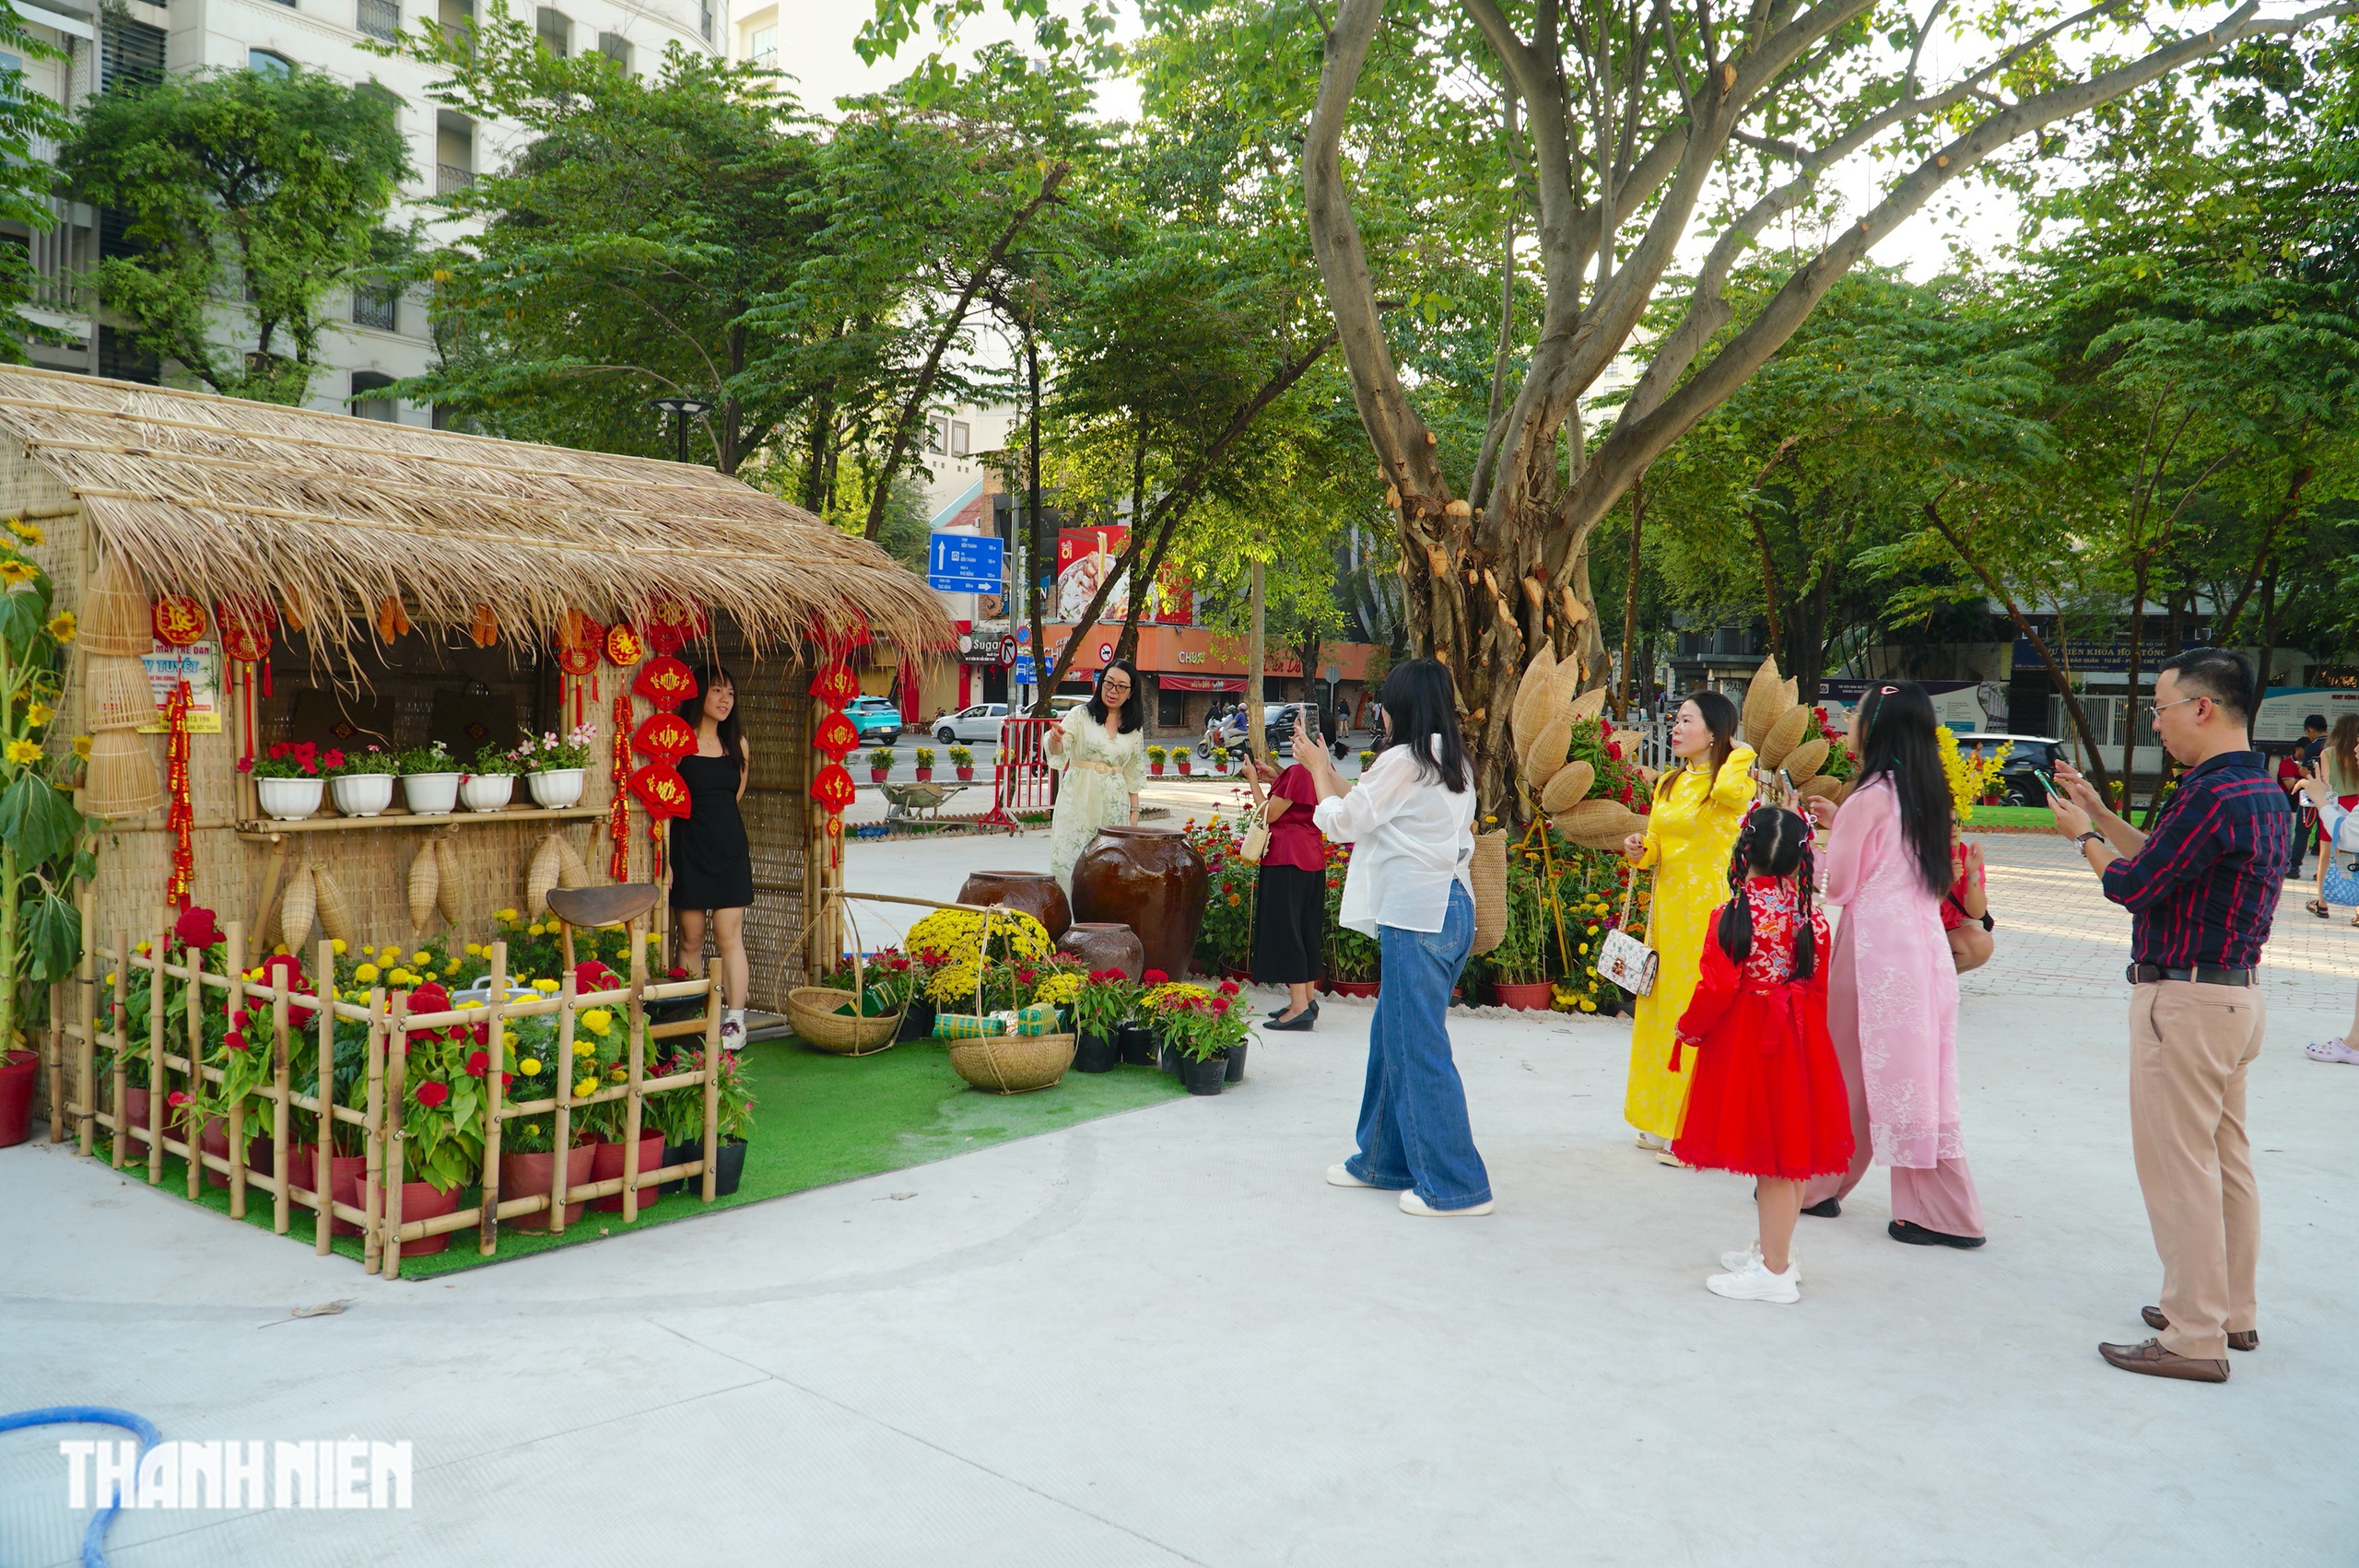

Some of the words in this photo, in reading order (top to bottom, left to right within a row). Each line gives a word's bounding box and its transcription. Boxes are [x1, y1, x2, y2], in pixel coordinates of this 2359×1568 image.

[973, 638, 1002, 652] Suga
[2118, 648, 2130, 657] HỌ
[659, 723, 679, 749] NĂM
